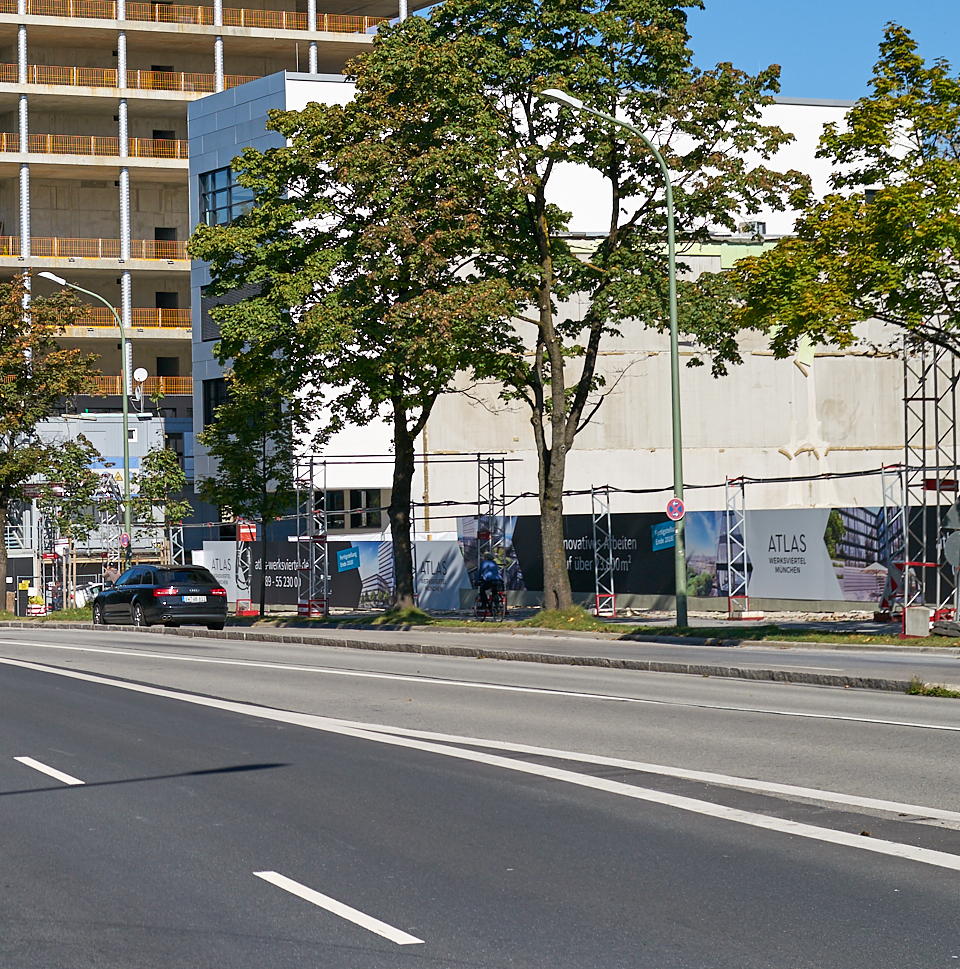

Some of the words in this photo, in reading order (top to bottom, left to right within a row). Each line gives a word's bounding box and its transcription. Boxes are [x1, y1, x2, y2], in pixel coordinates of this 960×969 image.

[768, 534, 807, 553] ATLAS
[211, 558, 232, 571] ATLAS
[420, 560, 447, 576] ATLAS
[574, 556, 593, 571] über
[768, 557, 807, 565] WERKSVIERTEL
[774, 565, 801, 574] MÜNCHEN
